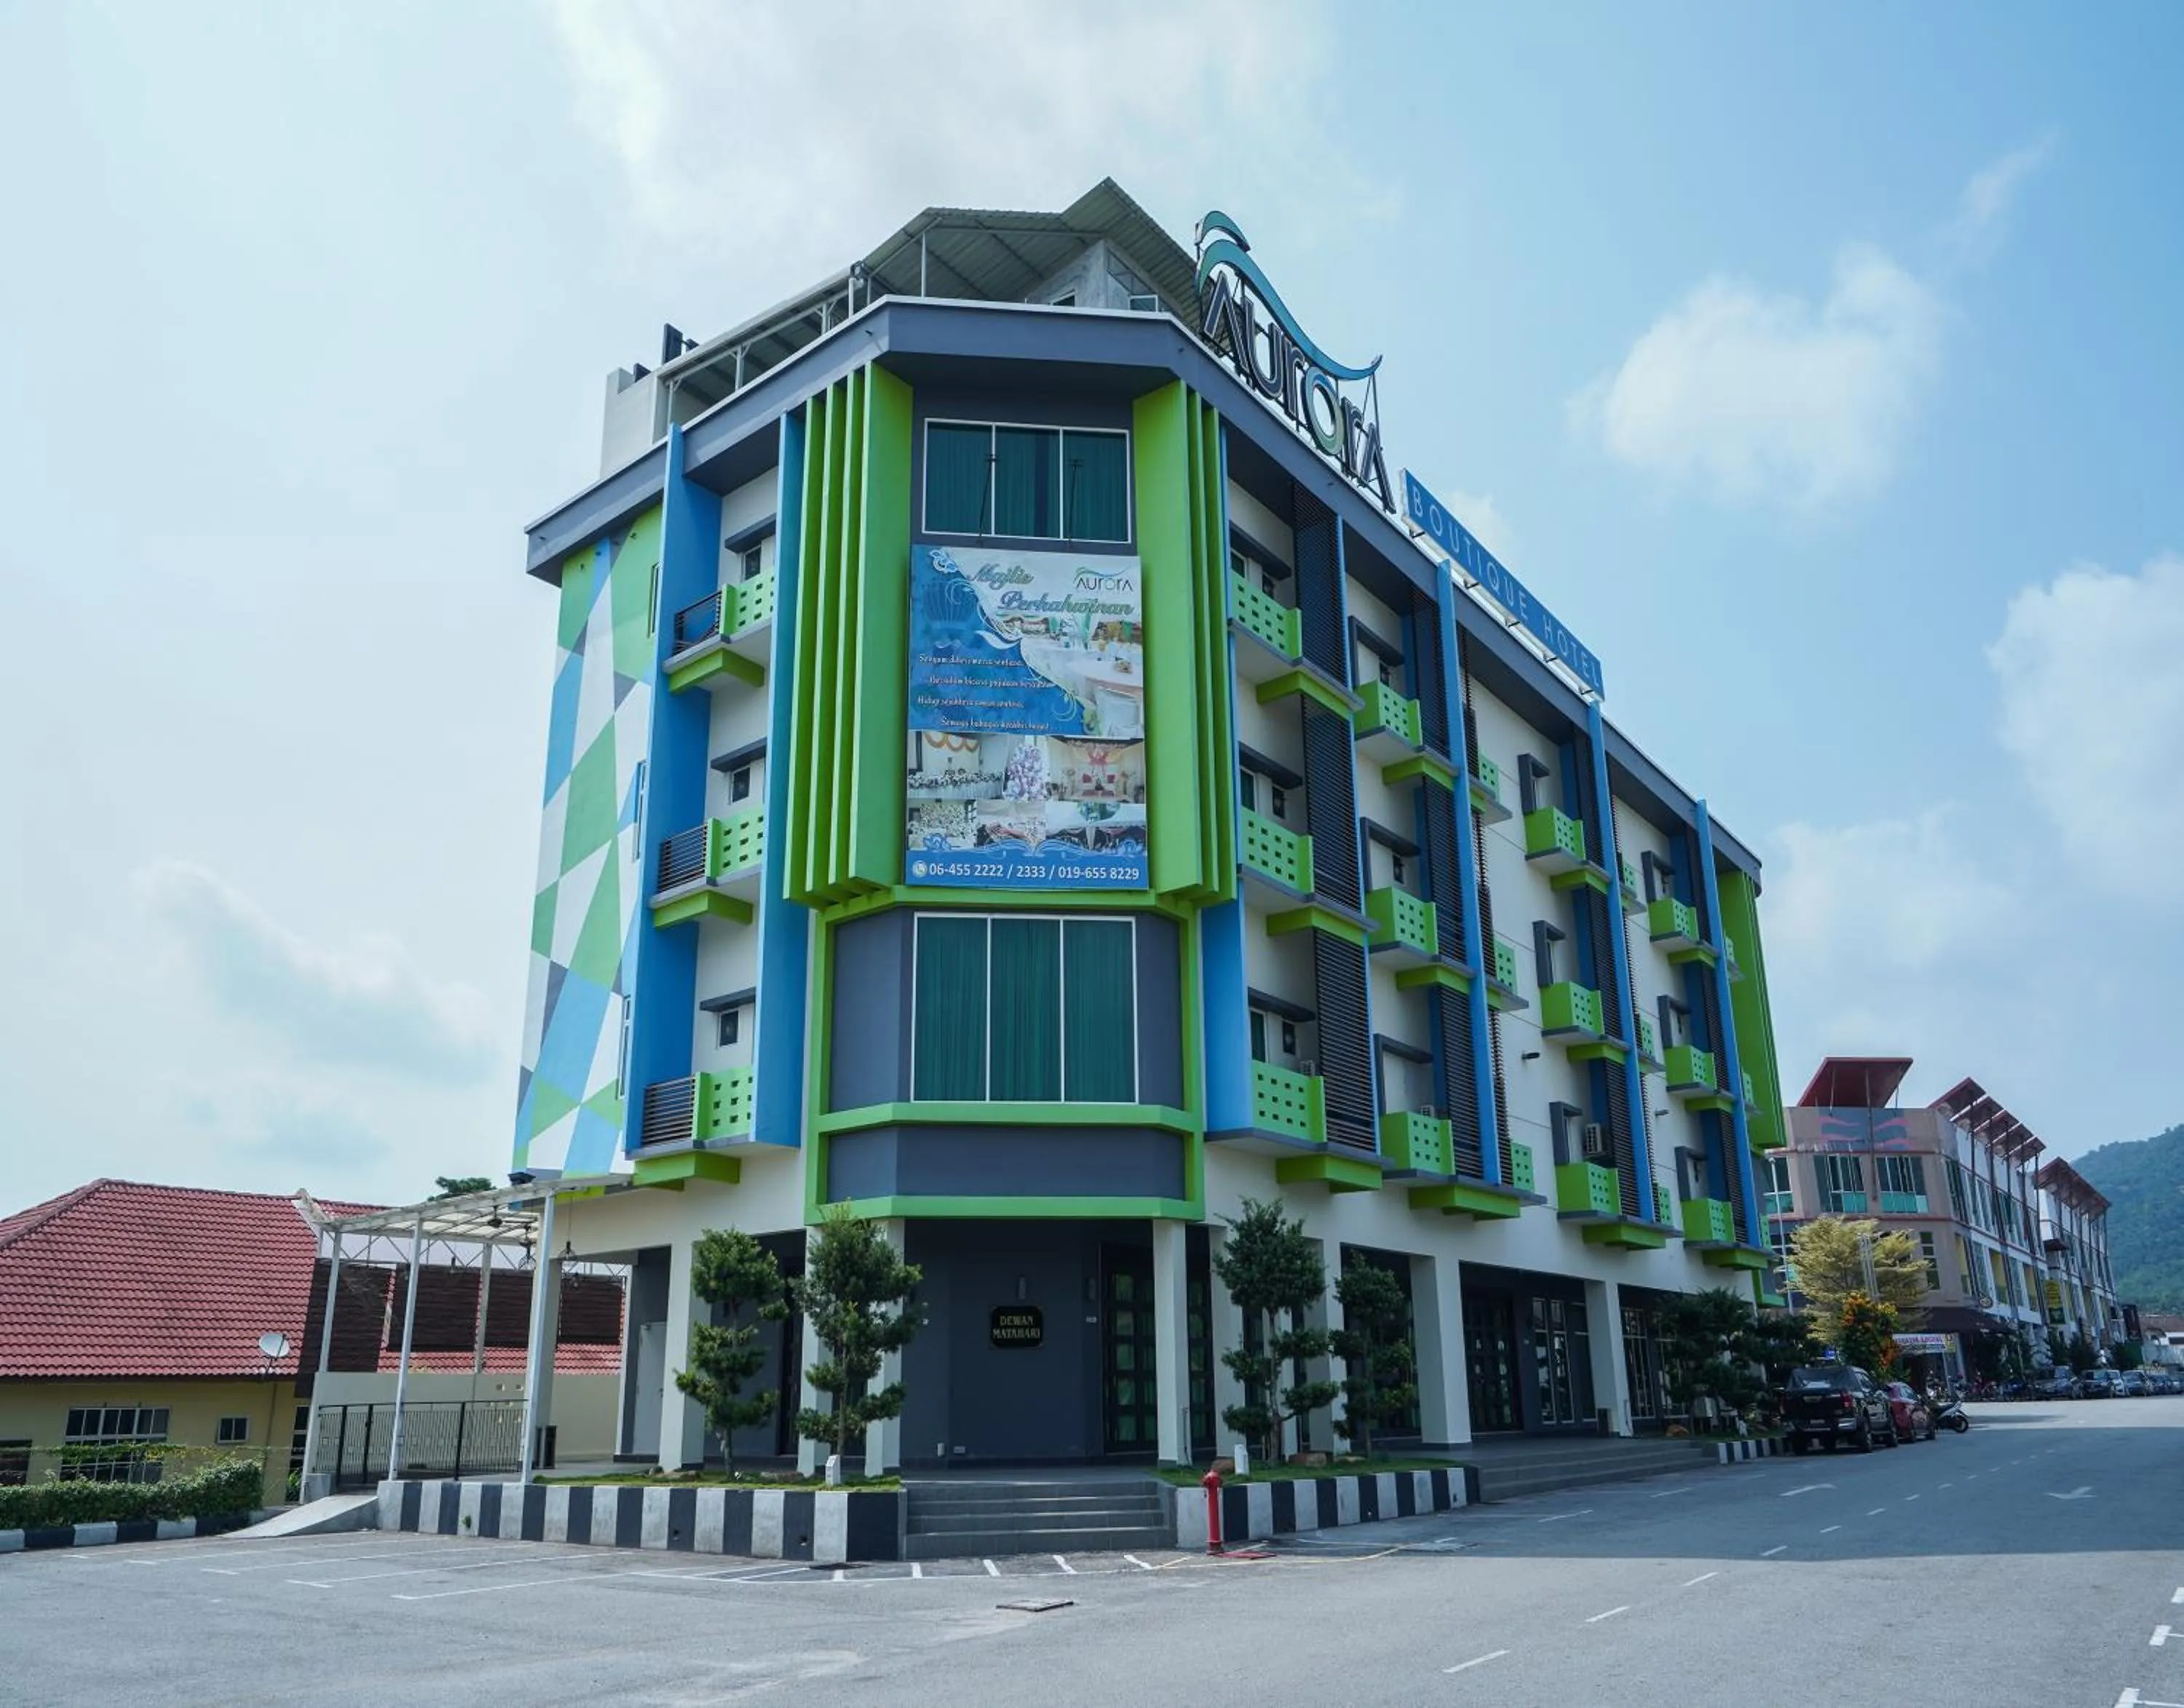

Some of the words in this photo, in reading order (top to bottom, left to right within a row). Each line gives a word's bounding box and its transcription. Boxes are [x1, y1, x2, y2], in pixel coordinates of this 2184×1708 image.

[1412, 486, 1527, 619] BOUTIQUE
[1543, 614, 1600, 687] HOTEL
[929, 863, 970, 876] 06-455
[975, 864, 1003, 877] 2222
[1016, 866, 1045, 878] 2333
[1059, 866, 1107, 879] 019-655
[1110, 866, 1139, 880] 8229
[1000, 1316, 1033, 1326] DEWAN
[992, 1328, 1040, 1339] MATAHARI
